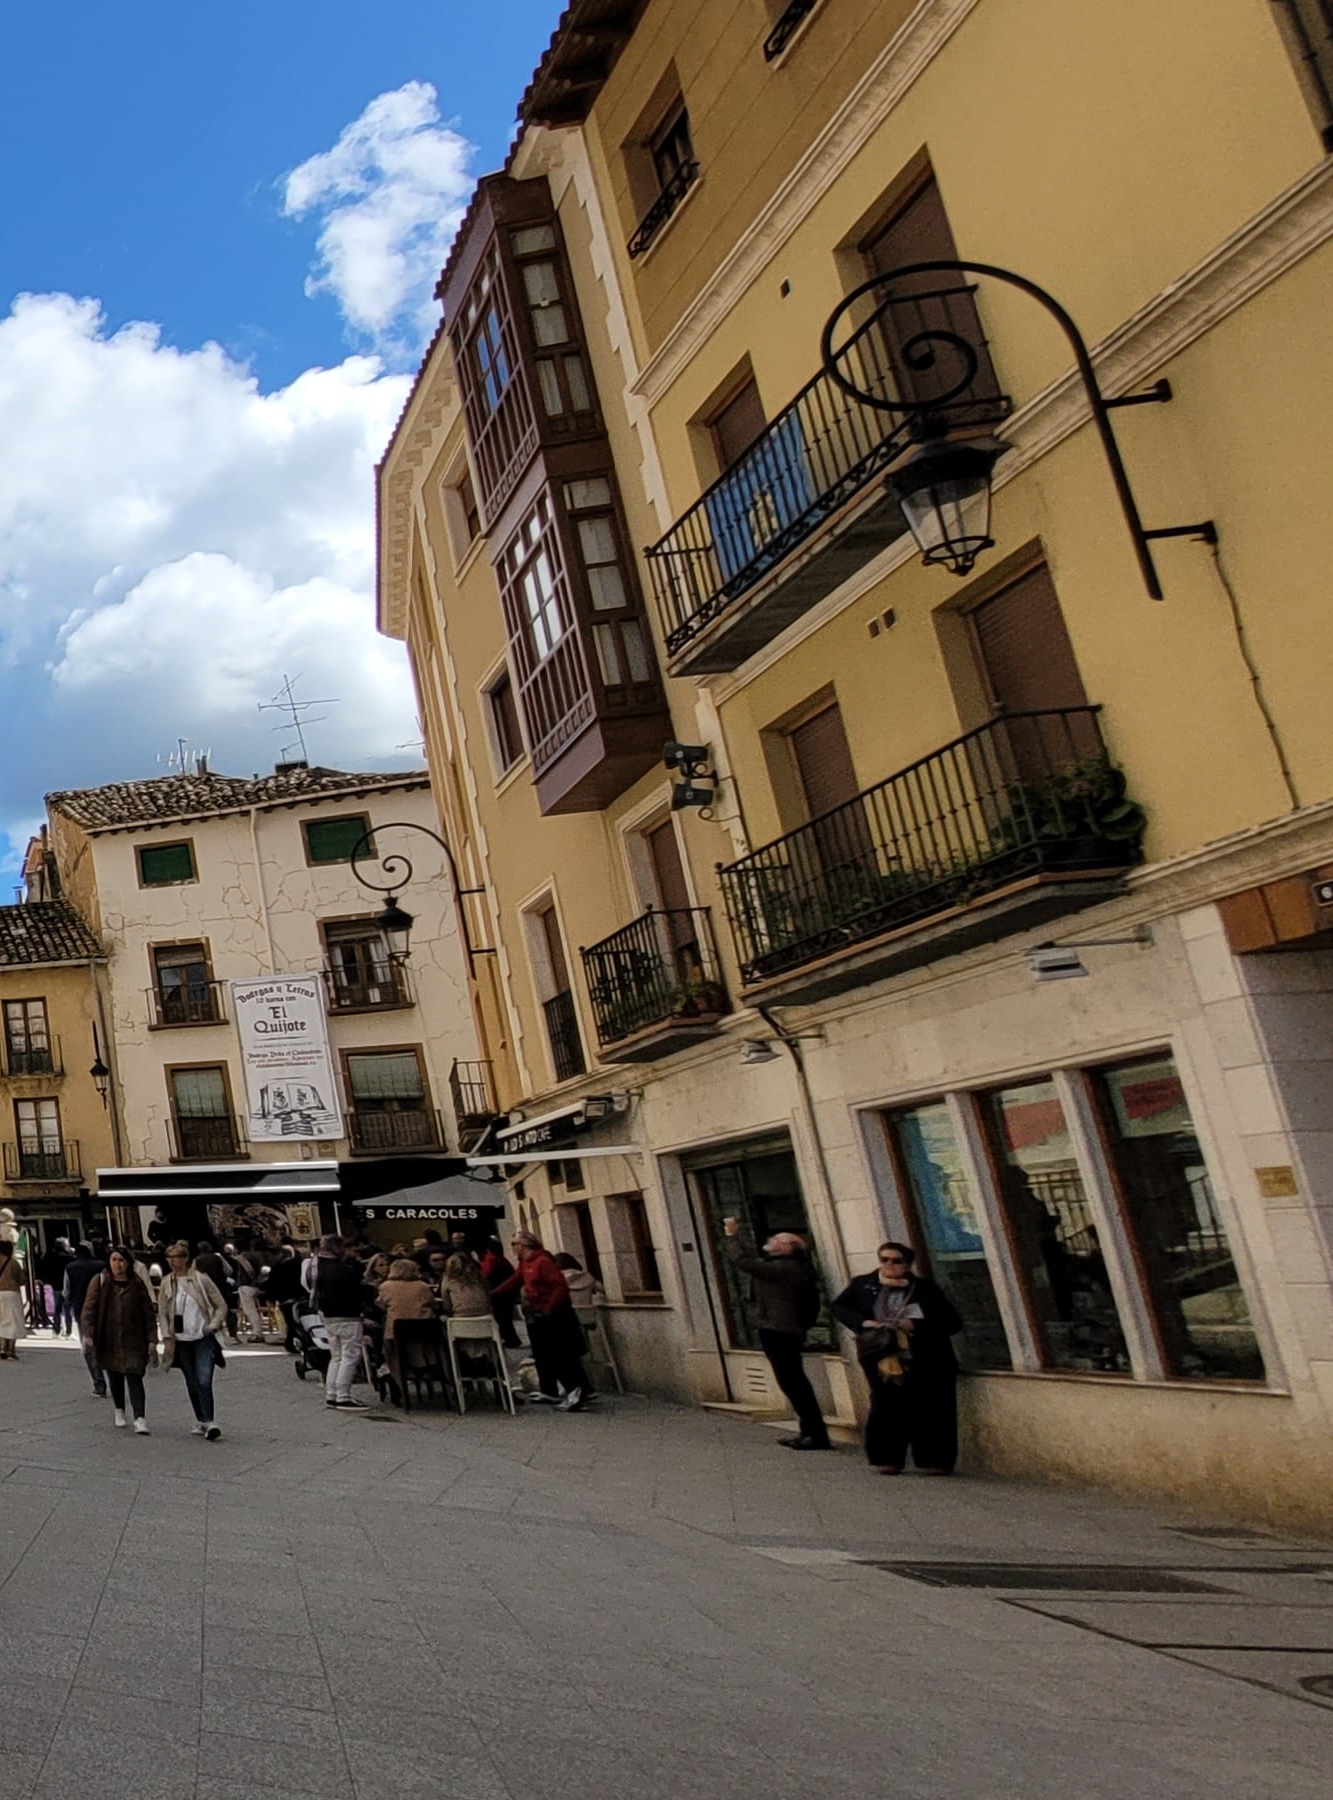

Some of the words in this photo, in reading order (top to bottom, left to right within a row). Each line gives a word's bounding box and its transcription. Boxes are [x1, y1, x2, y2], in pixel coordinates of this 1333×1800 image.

[269, 1006, 287, 1019] El
[254, 1020, 307, 1034] Quijote
[386, 1209, 478, 1219] CARACOLES
